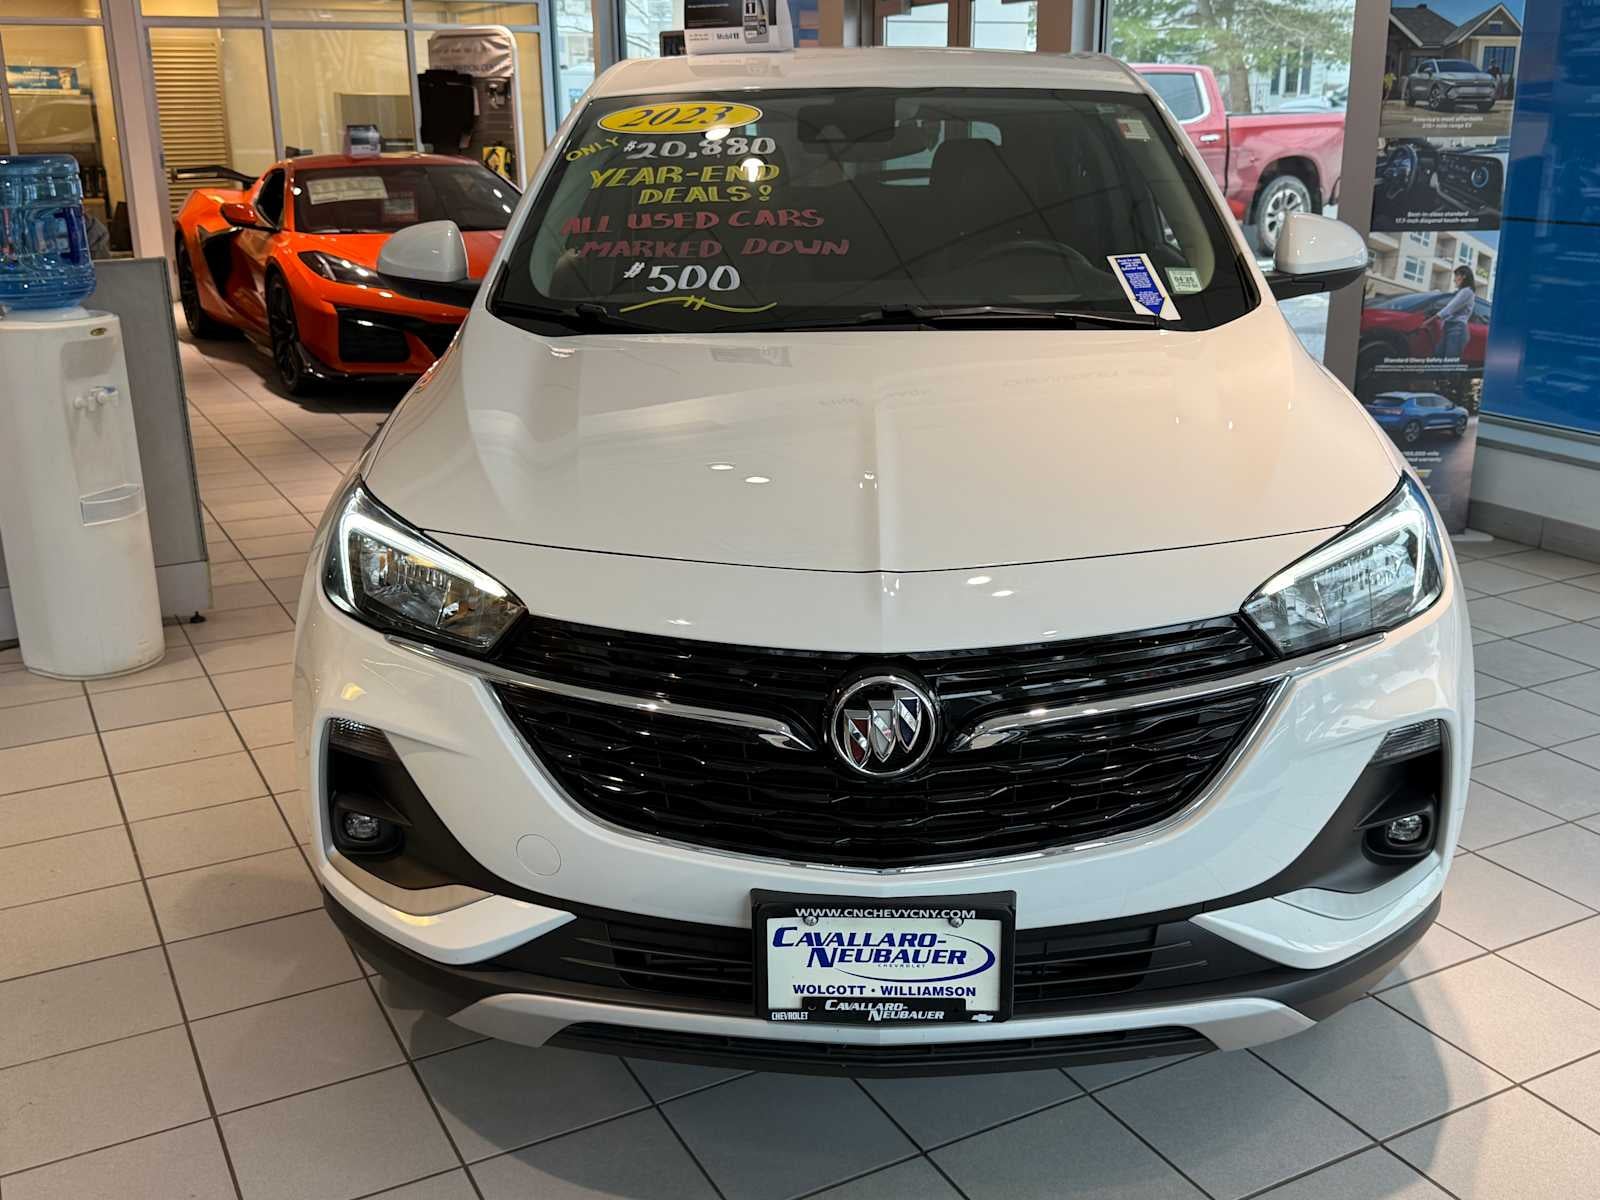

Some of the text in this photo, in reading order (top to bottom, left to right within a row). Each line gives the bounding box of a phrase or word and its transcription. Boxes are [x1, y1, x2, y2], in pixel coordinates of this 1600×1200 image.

[620, 106, 734, 128] 2023
[565, 136, 620, 162] ONLY
[590, 164, 780, 189] YEAR-END
[638, 184, 773, 205] DEALS!
[560, 208, 825, 237] ALL USED CARS
[576, 238, 850, 258] MARKED DOWN
[795, 908, 976, 919] WWW.CNCHEVYCNY.COM
[806, 947, 967, 968] NEUBAUER
[793, 984, 977, 997] WOLCOTT WILLIAMSON
[772, 1011, 809, 1021] CHEVROLET
[868, 1010, 945, 1021] NEUBAUER
